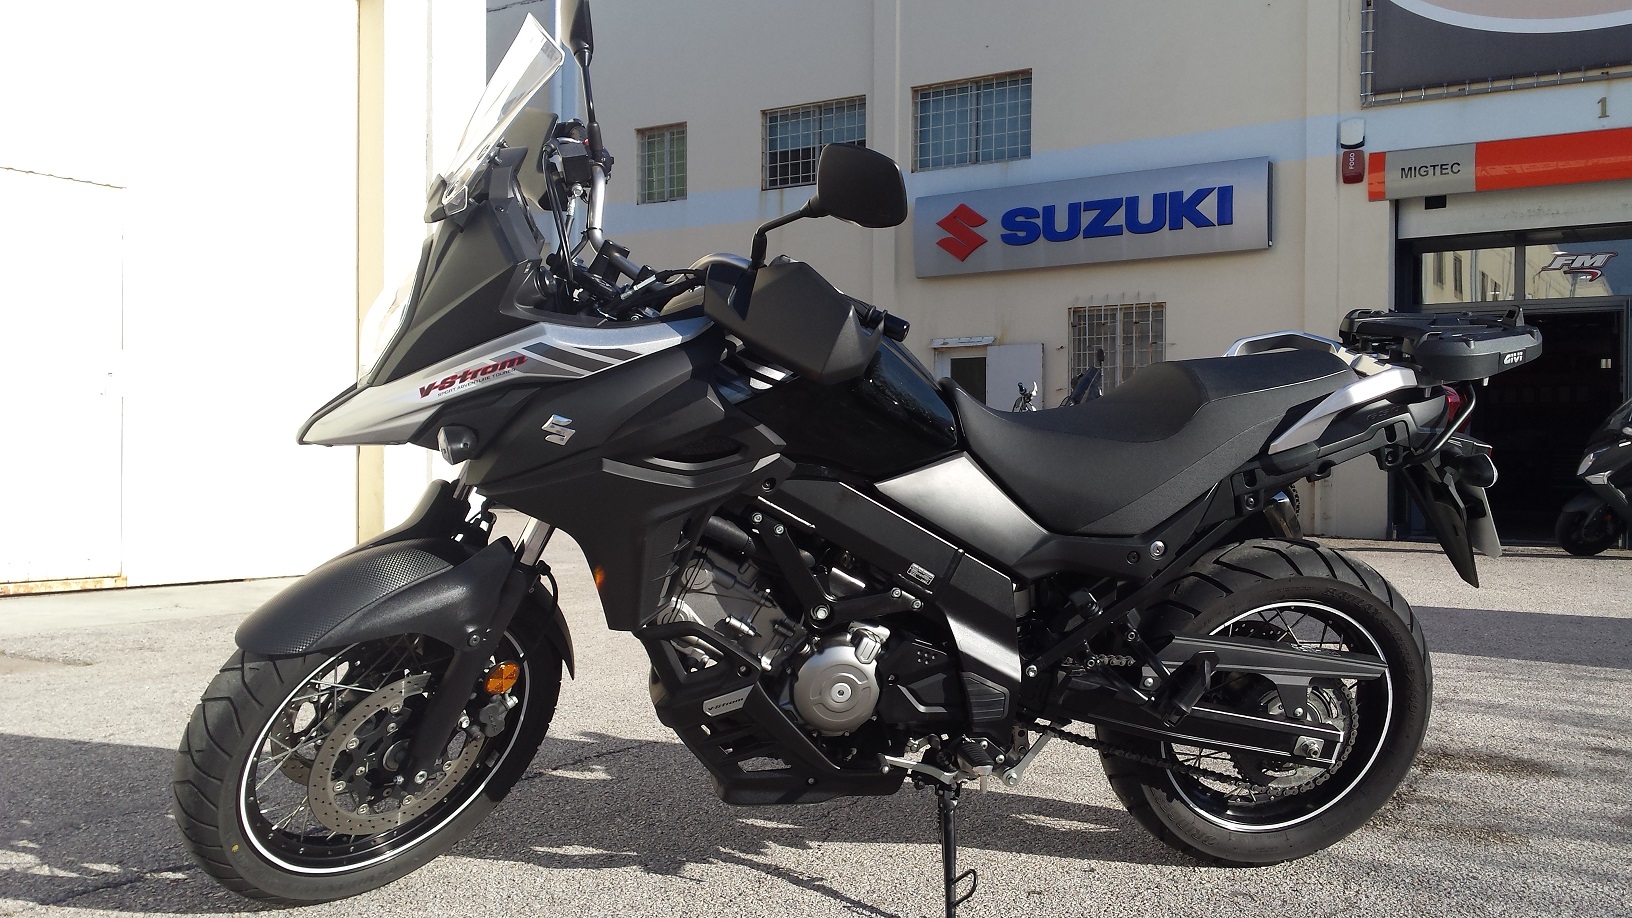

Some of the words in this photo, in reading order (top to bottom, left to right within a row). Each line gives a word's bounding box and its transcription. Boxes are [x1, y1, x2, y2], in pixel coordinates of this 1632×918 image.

[1597, 97, 1610, 119] 1
[1400, 162, 1461, 179] MIGTEC
[1001, 185, 1234, 246] SUZUKI
[1546, 252, 1614, 270] FM
[1503, 351, 1524, 365] GIVI
[457, 376, 491, 390] ADVENTURE
